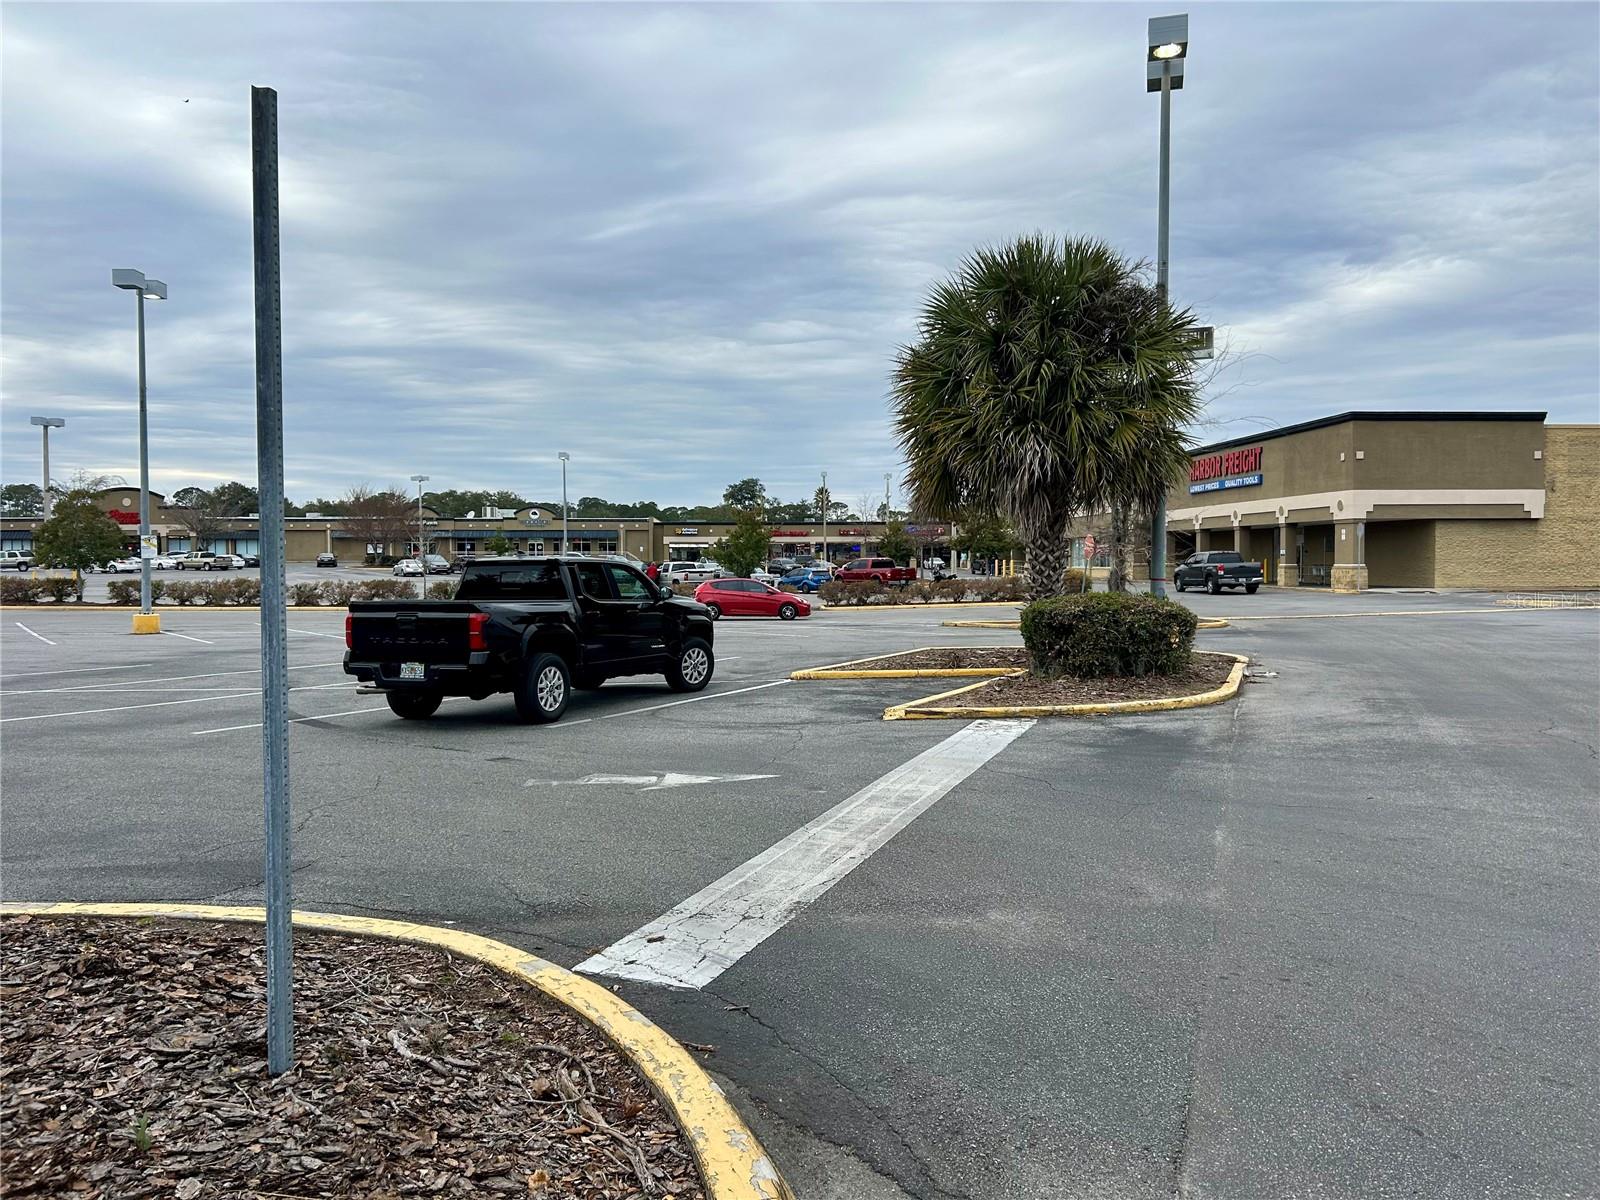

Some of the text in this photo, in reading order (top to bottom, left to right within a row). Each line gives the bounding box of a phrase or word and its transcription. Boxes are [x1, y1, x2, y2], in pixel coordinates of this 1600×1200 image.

[1190, 447, 1263, 481] HARBOR FREIGHT
[1190, 475, 1258, 493] LOWEST PRICES QUALITY TOOLS
